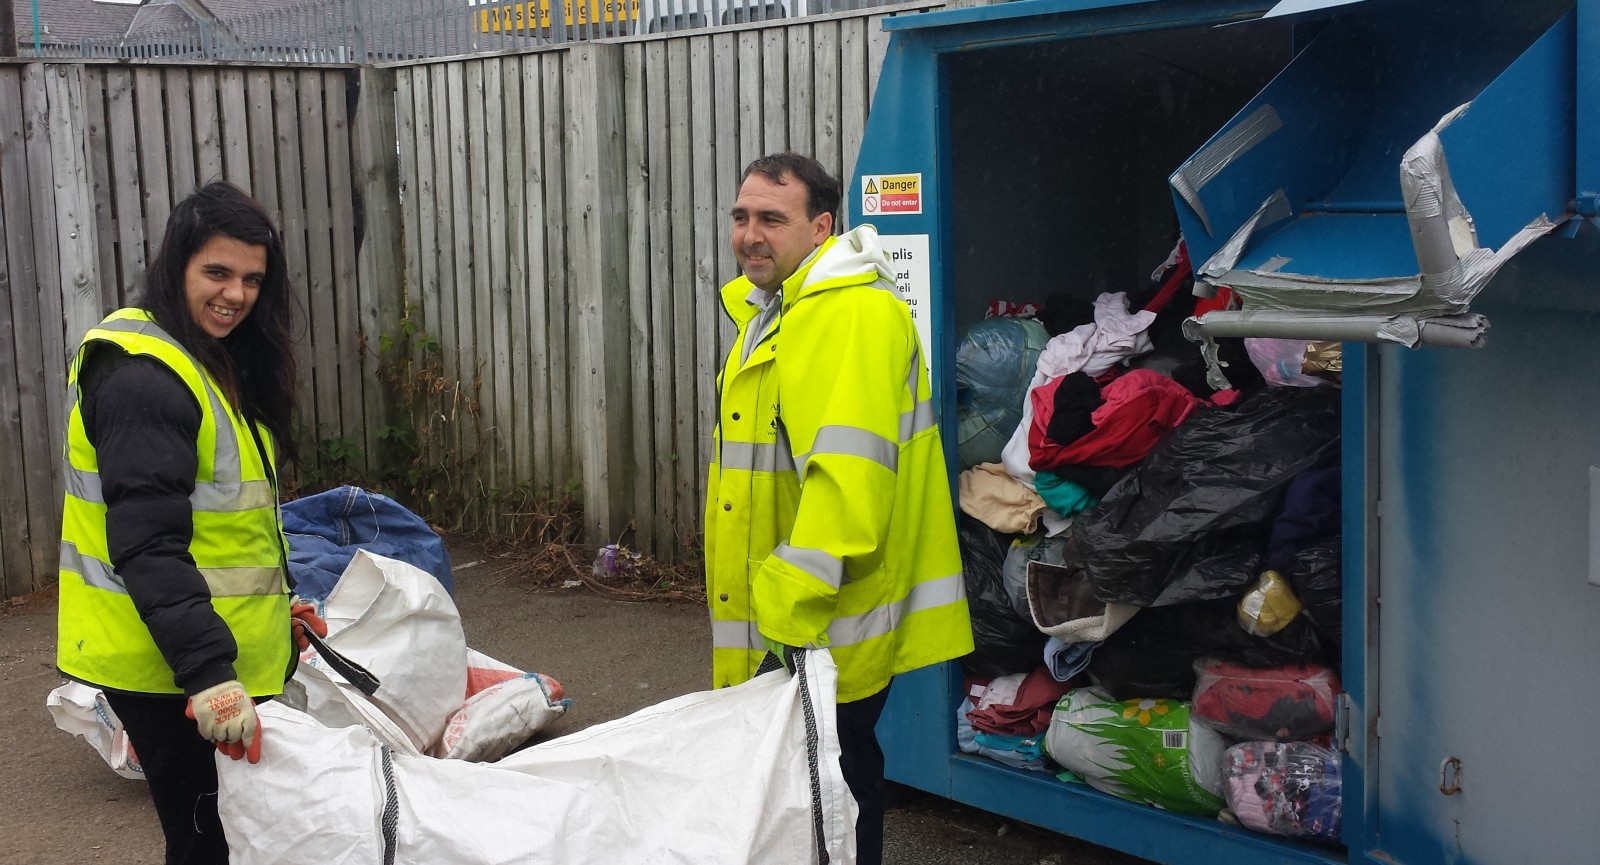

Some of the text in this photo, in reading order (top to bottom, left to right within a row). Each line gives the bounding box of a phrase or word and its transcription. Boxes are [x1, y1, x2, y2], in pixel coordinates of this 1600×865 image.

[882, 180, 916, 191] Danger
[218, 703, 237, 715] 2000
[214, 708, 241, 724] CLICK
